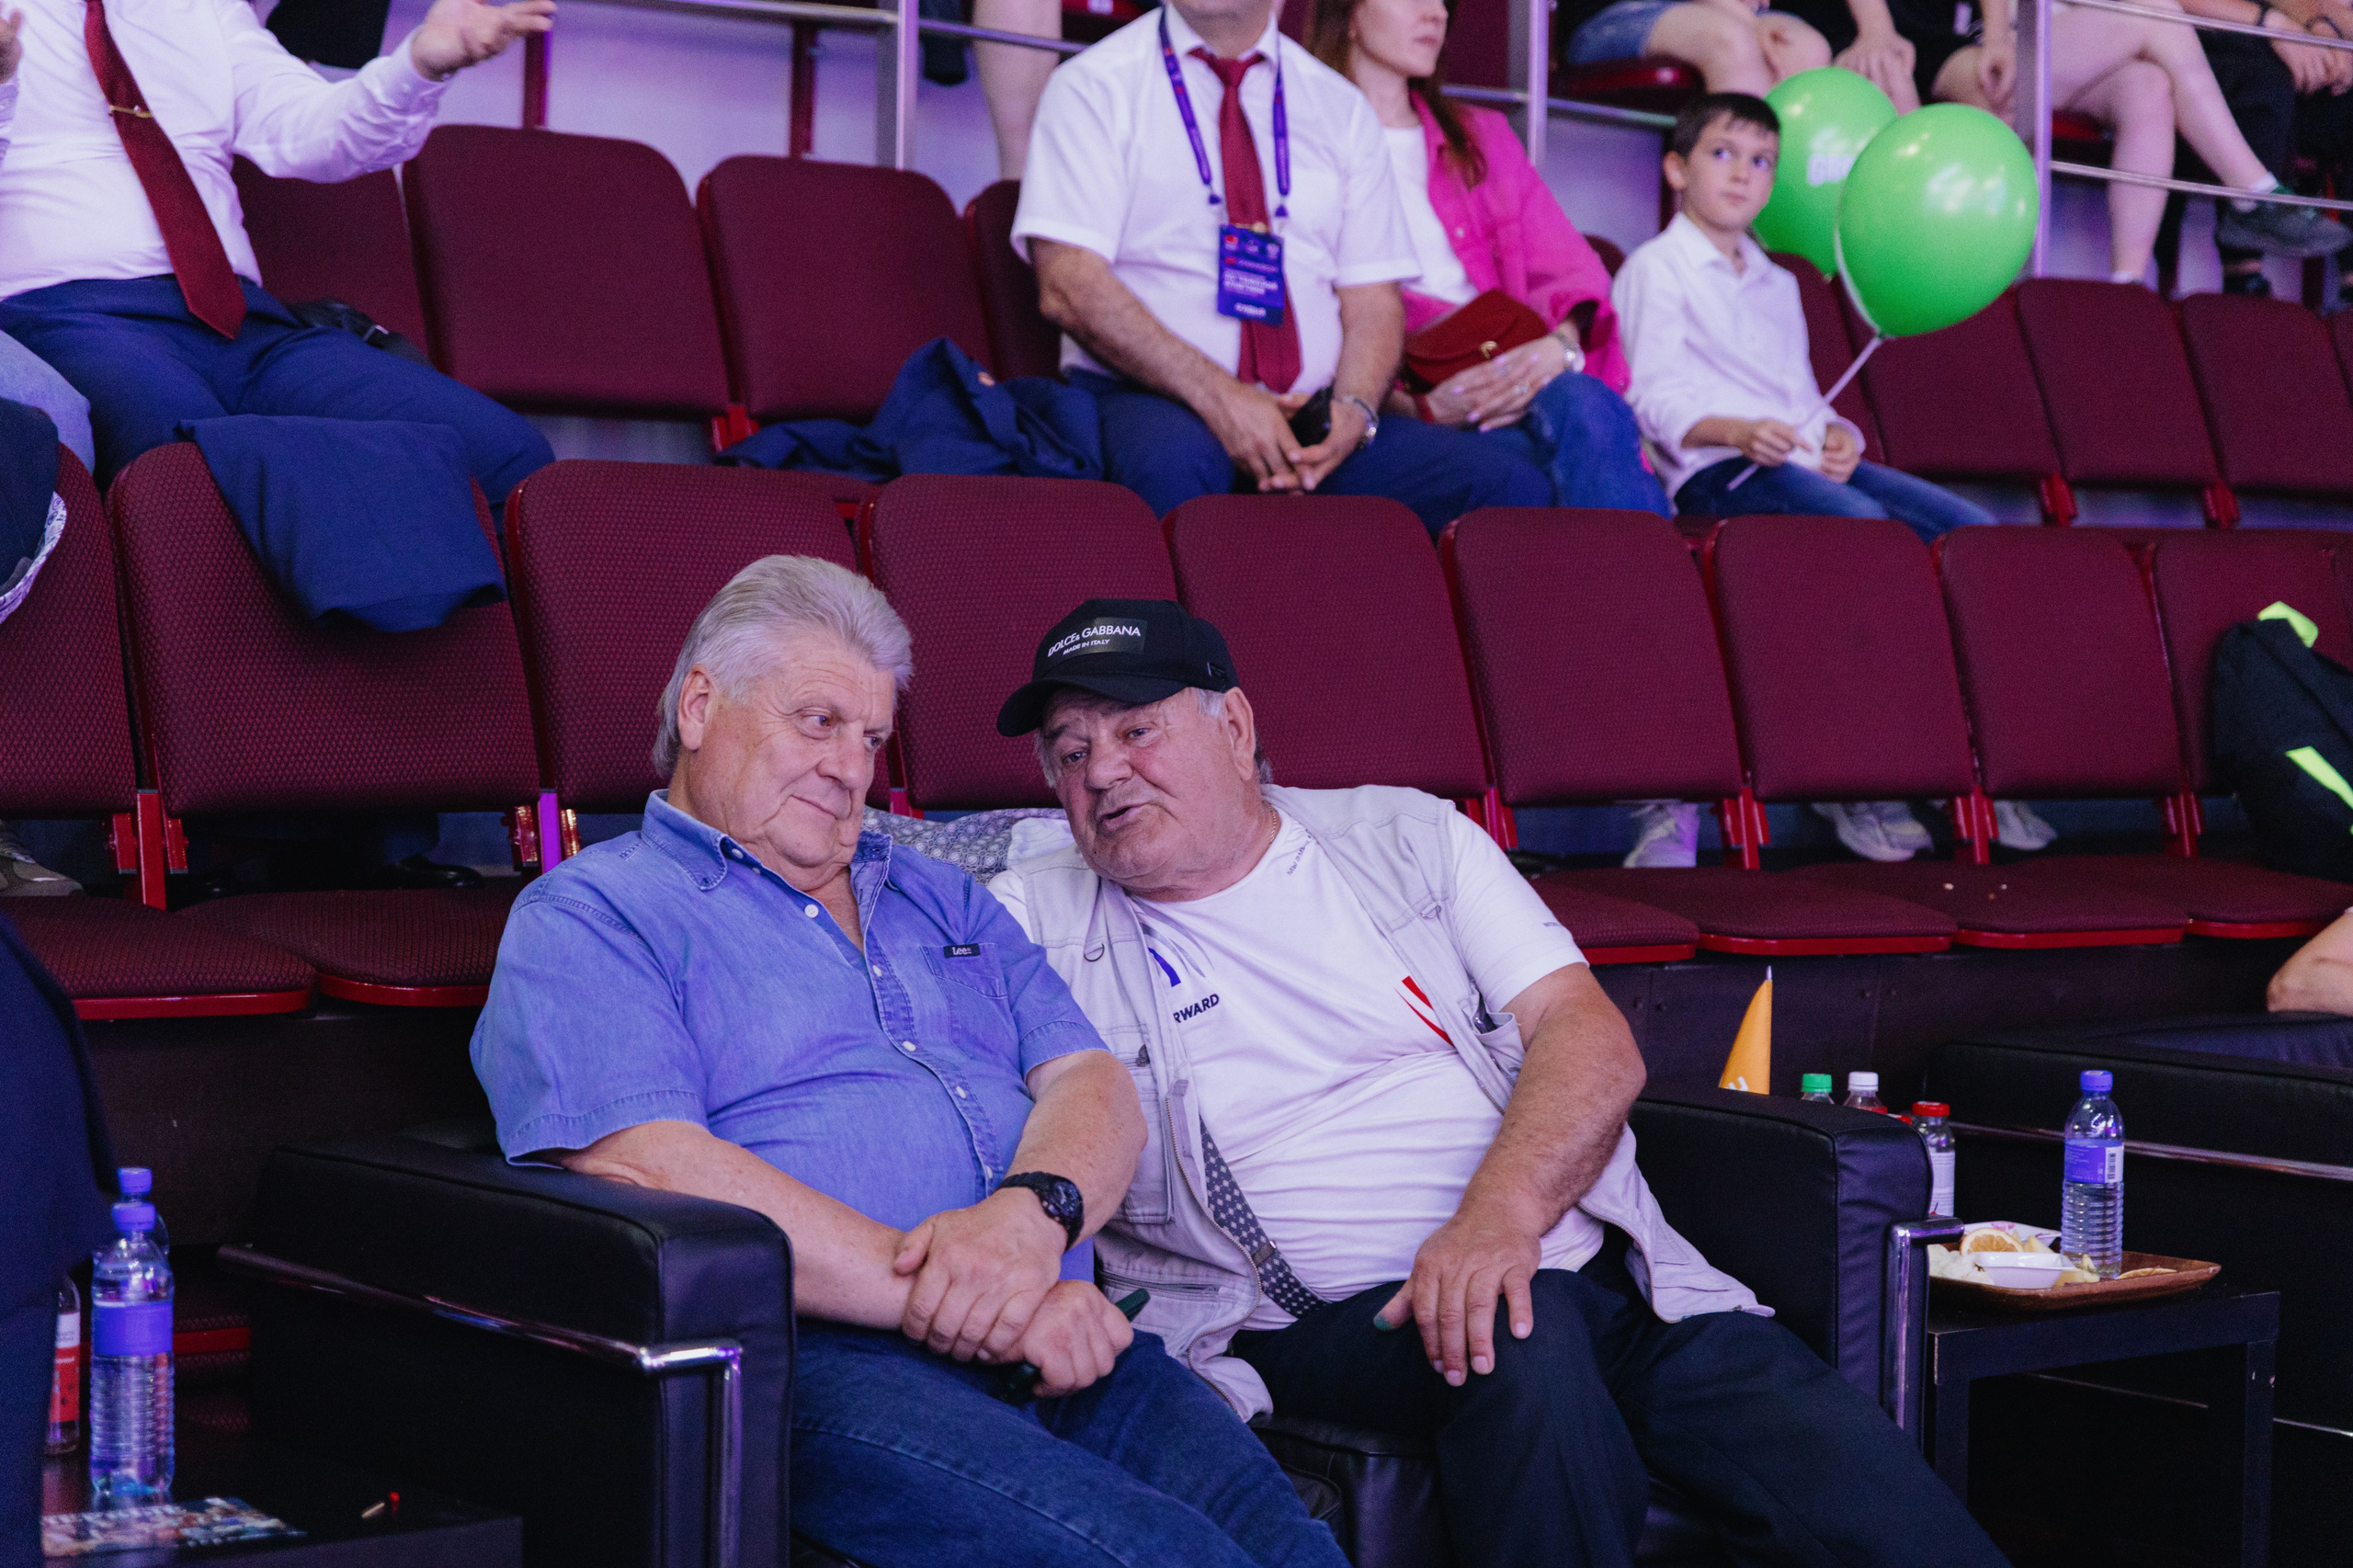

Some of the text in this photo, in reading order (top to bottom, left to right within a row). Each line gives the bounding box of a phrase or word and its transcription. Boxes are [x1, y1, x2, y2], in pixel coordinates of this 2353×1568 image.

[1082, 625, 1141, 638] GABBANA
[1063, 643, 1081, 655] MADE
[1173, 994, 1220, 1023] RWARD
